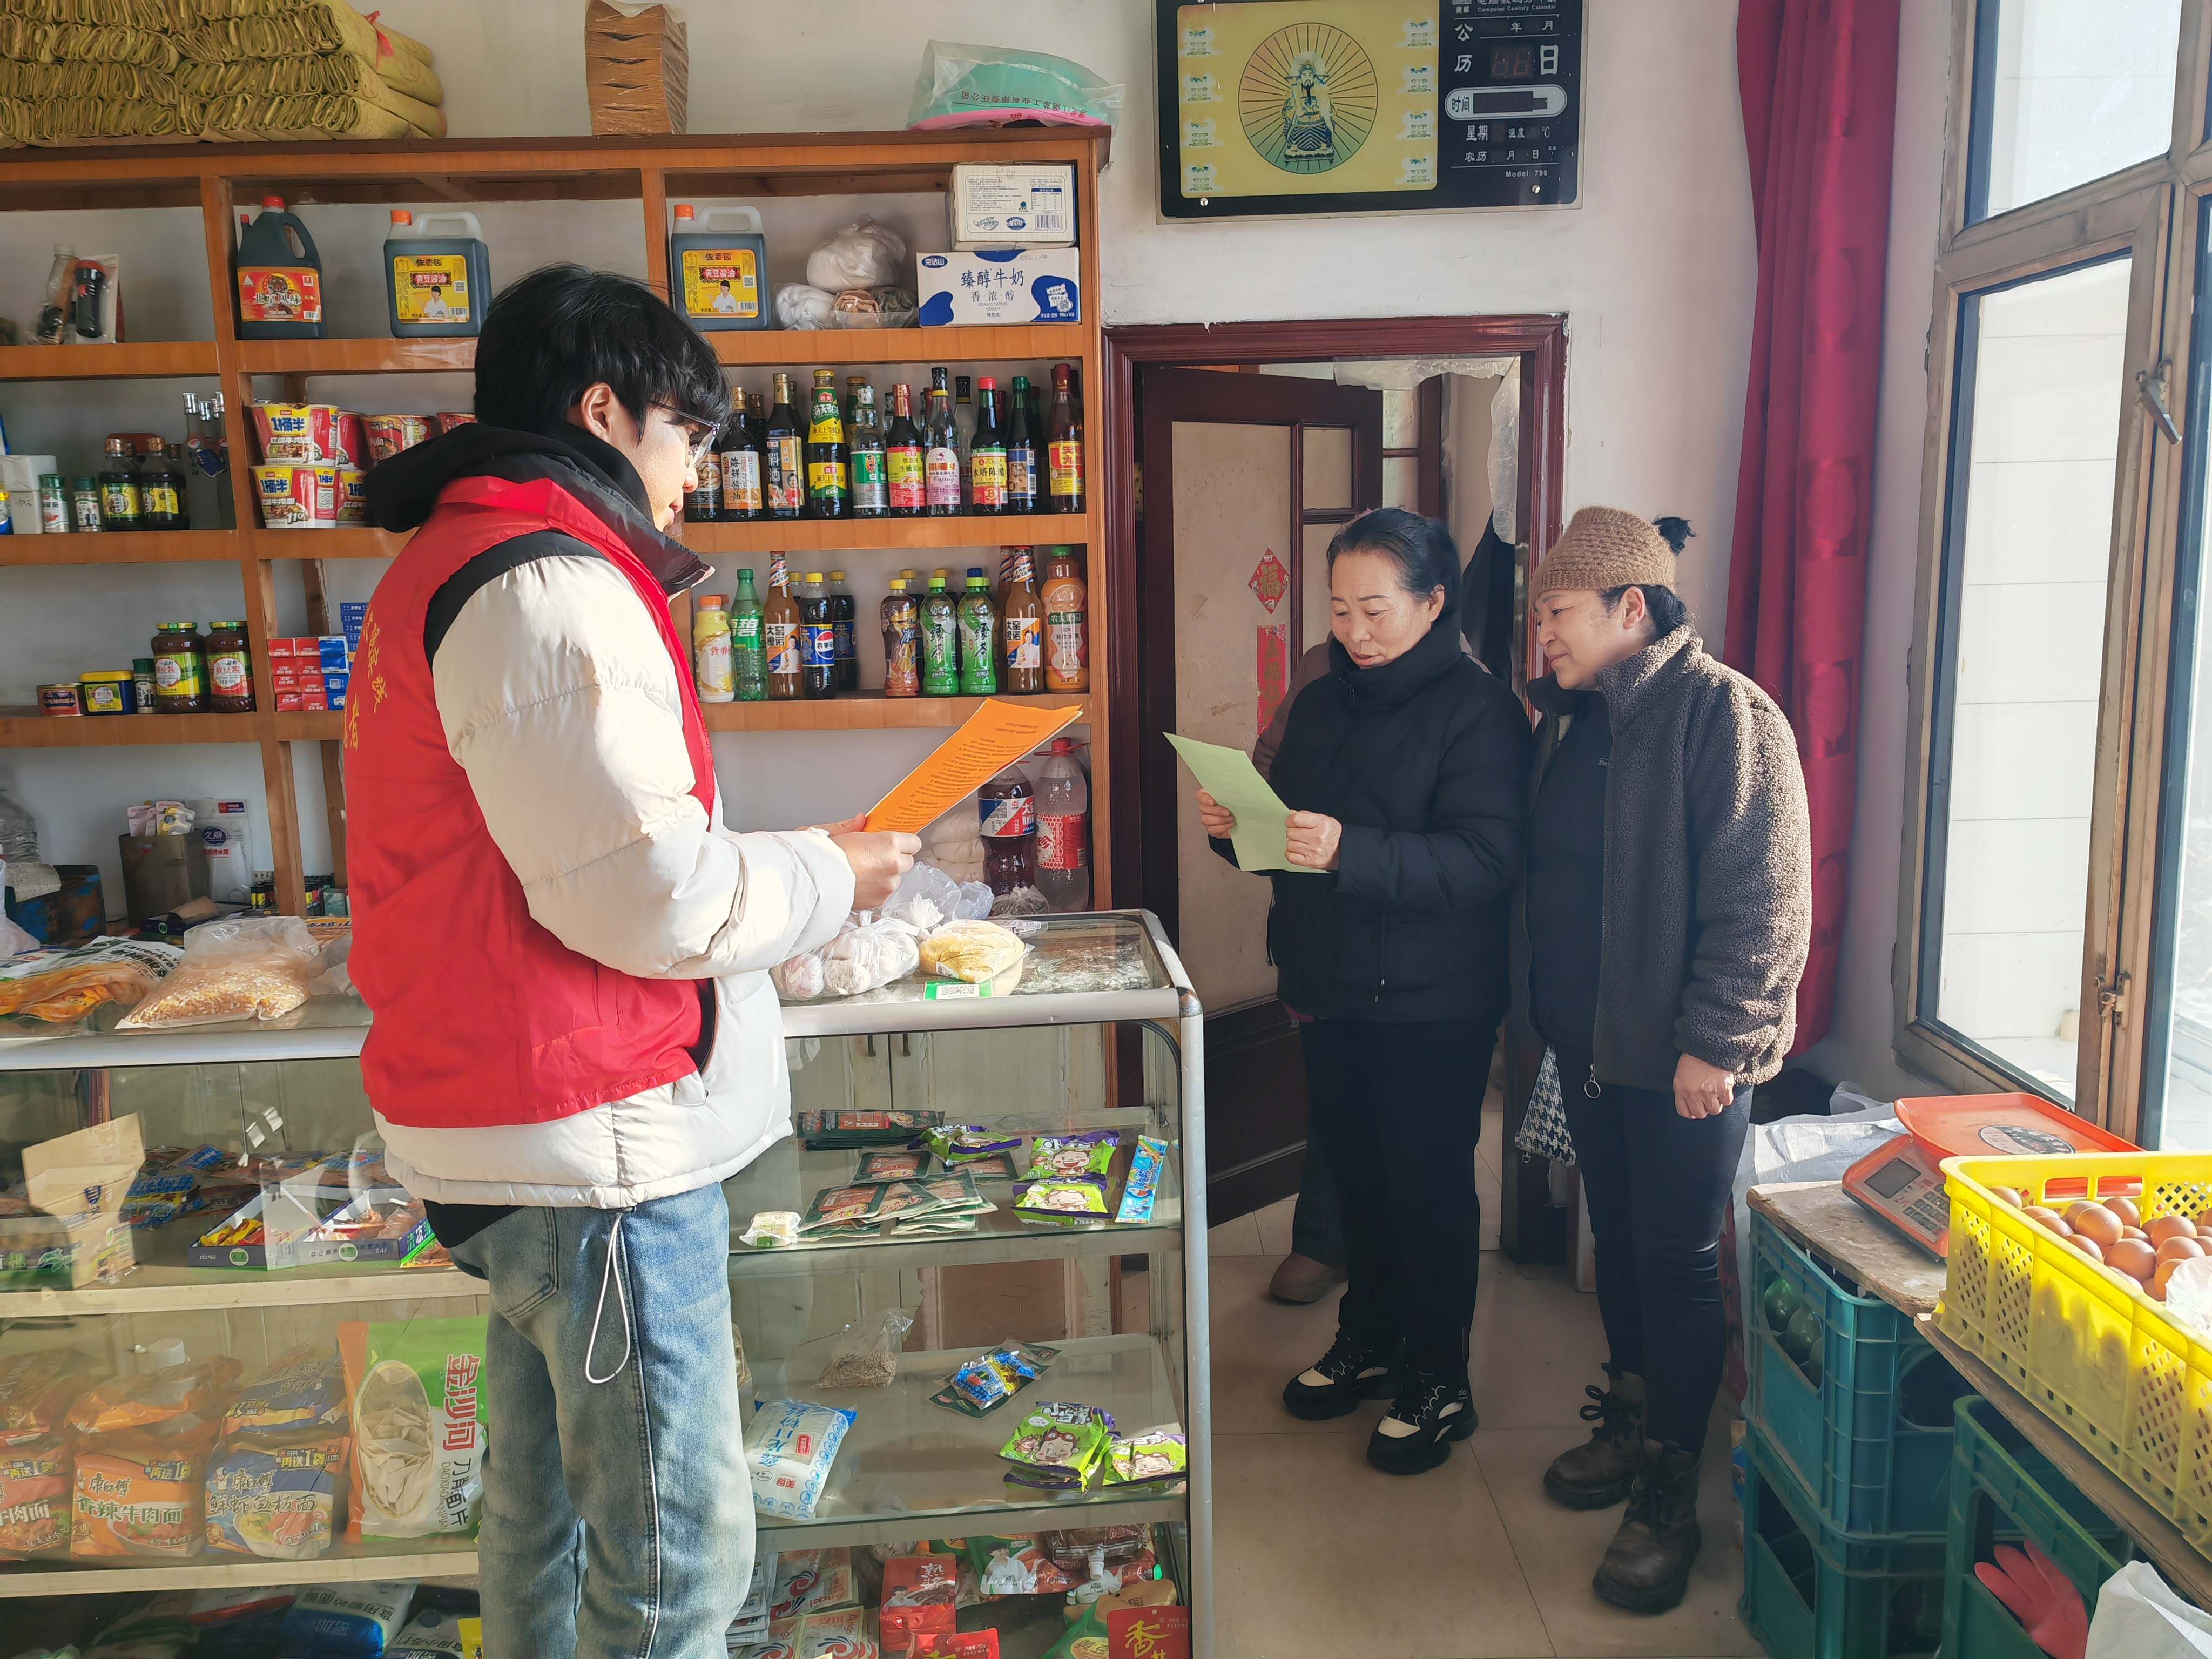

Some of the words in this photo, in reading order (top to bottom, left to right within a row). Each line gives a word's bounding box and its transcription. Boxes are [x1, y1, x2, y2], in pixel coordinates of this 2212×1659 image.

[1455, 23, 1473, 41] 公
[1510, 21, 1522, 33] 年
[1542, 20, 1553, 31] 月
[1454, 55, 1473, 72] 历
[1540, 44, 1559, 76] 日
[1452, 96, 1469, 112] 时间
[1466, 125, 1488, 141] 星期
[1508, 127, 1525, 138] 温度
[1465, 151, 1487, 163] 农历
[1507, 150, 1515, 160] 月
[1532, 150, 1539, 159] 日
[925, 258, 945, 266] 完达山
[705, 269, 736, 278] 黄豆酱油
[961, 268, 1024, 289] 臻醇牛奶
[253, 292, 302, 306] 北京风味
[271, 417, 306, 432] 1桶半
[812, 426, 841, 435] 海天上等蚝油
[270, 436, 313, 444] 红烧牛肉面
[768, 452, 780, 482] 料酒
[973, 467, 1005, 477] 水塔陈醋
[260, 479, 288, 494] 1桶半
[730, 456, 742, 501] 海鲜酱油
[1260, 563, 1282, 598] 福
[1050, 613, 1081, 623] 农夫果园
[930, 623, 946, 662] 绿茶
[974, 623, 989, 660] 绿茶
[204, 831, 223, 839] 久丽
[1041, 1402, 1093, 1426] 小当家
[73, 1493, 185, 1525] 香辣牛肉面
[207, 1493, 318, 1516] 鲜虾鱼板面
